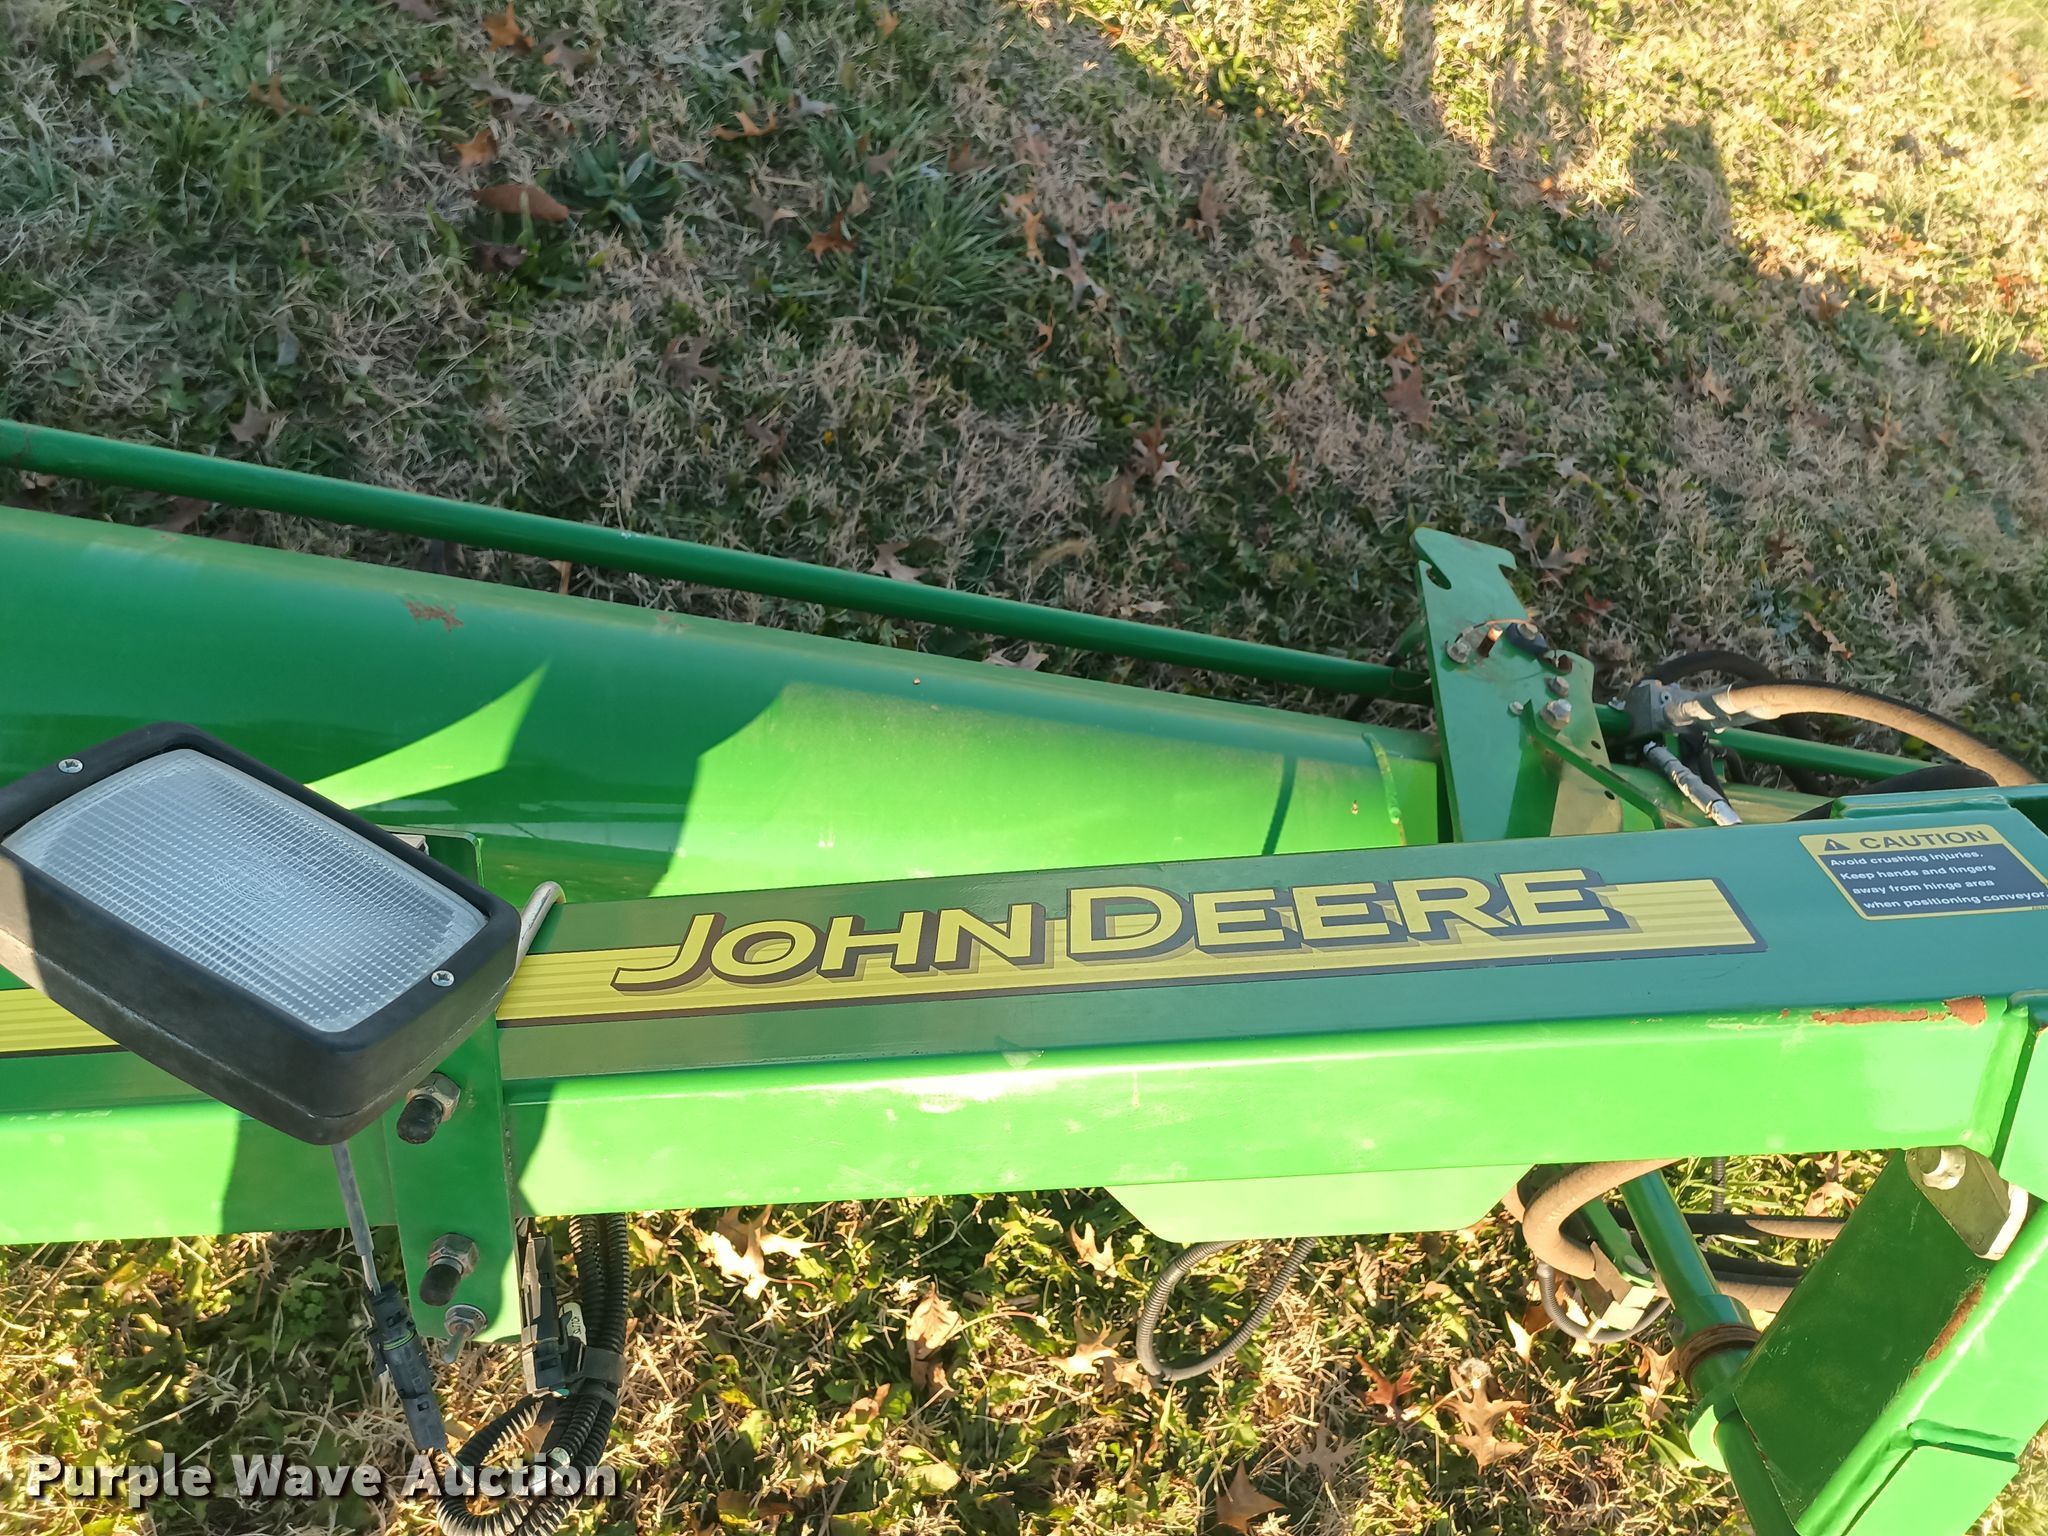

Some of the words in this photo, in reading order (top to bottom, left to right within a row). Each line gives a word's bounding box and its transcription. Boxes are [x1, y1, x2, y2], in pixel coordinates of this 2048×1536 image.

[1859, 830, 1990, 849] CAUTION
[1830, 857, 1868, 867] Avoid
[1869, 853, 1929, 864] crushing
[1839, 871, 1876, 880] Keep
[1876, 868, 1919, 878] hands
[1921, 866, 1948, 876] and
[1948, 864, 1997, 874] fingers
[1852, 886, 1887, 895] away
[1888, 884, 1922, 893] from
[1922, 881, 1963, 891] hinge
[1964, 879, 1996, 889] area
[1863, 900, 1901, 909] when
[1902, 894, 1982, 909] positioning
[609, 902, 1045, 995] JOHN
[1066, 867, 1626, 964] DEERE
